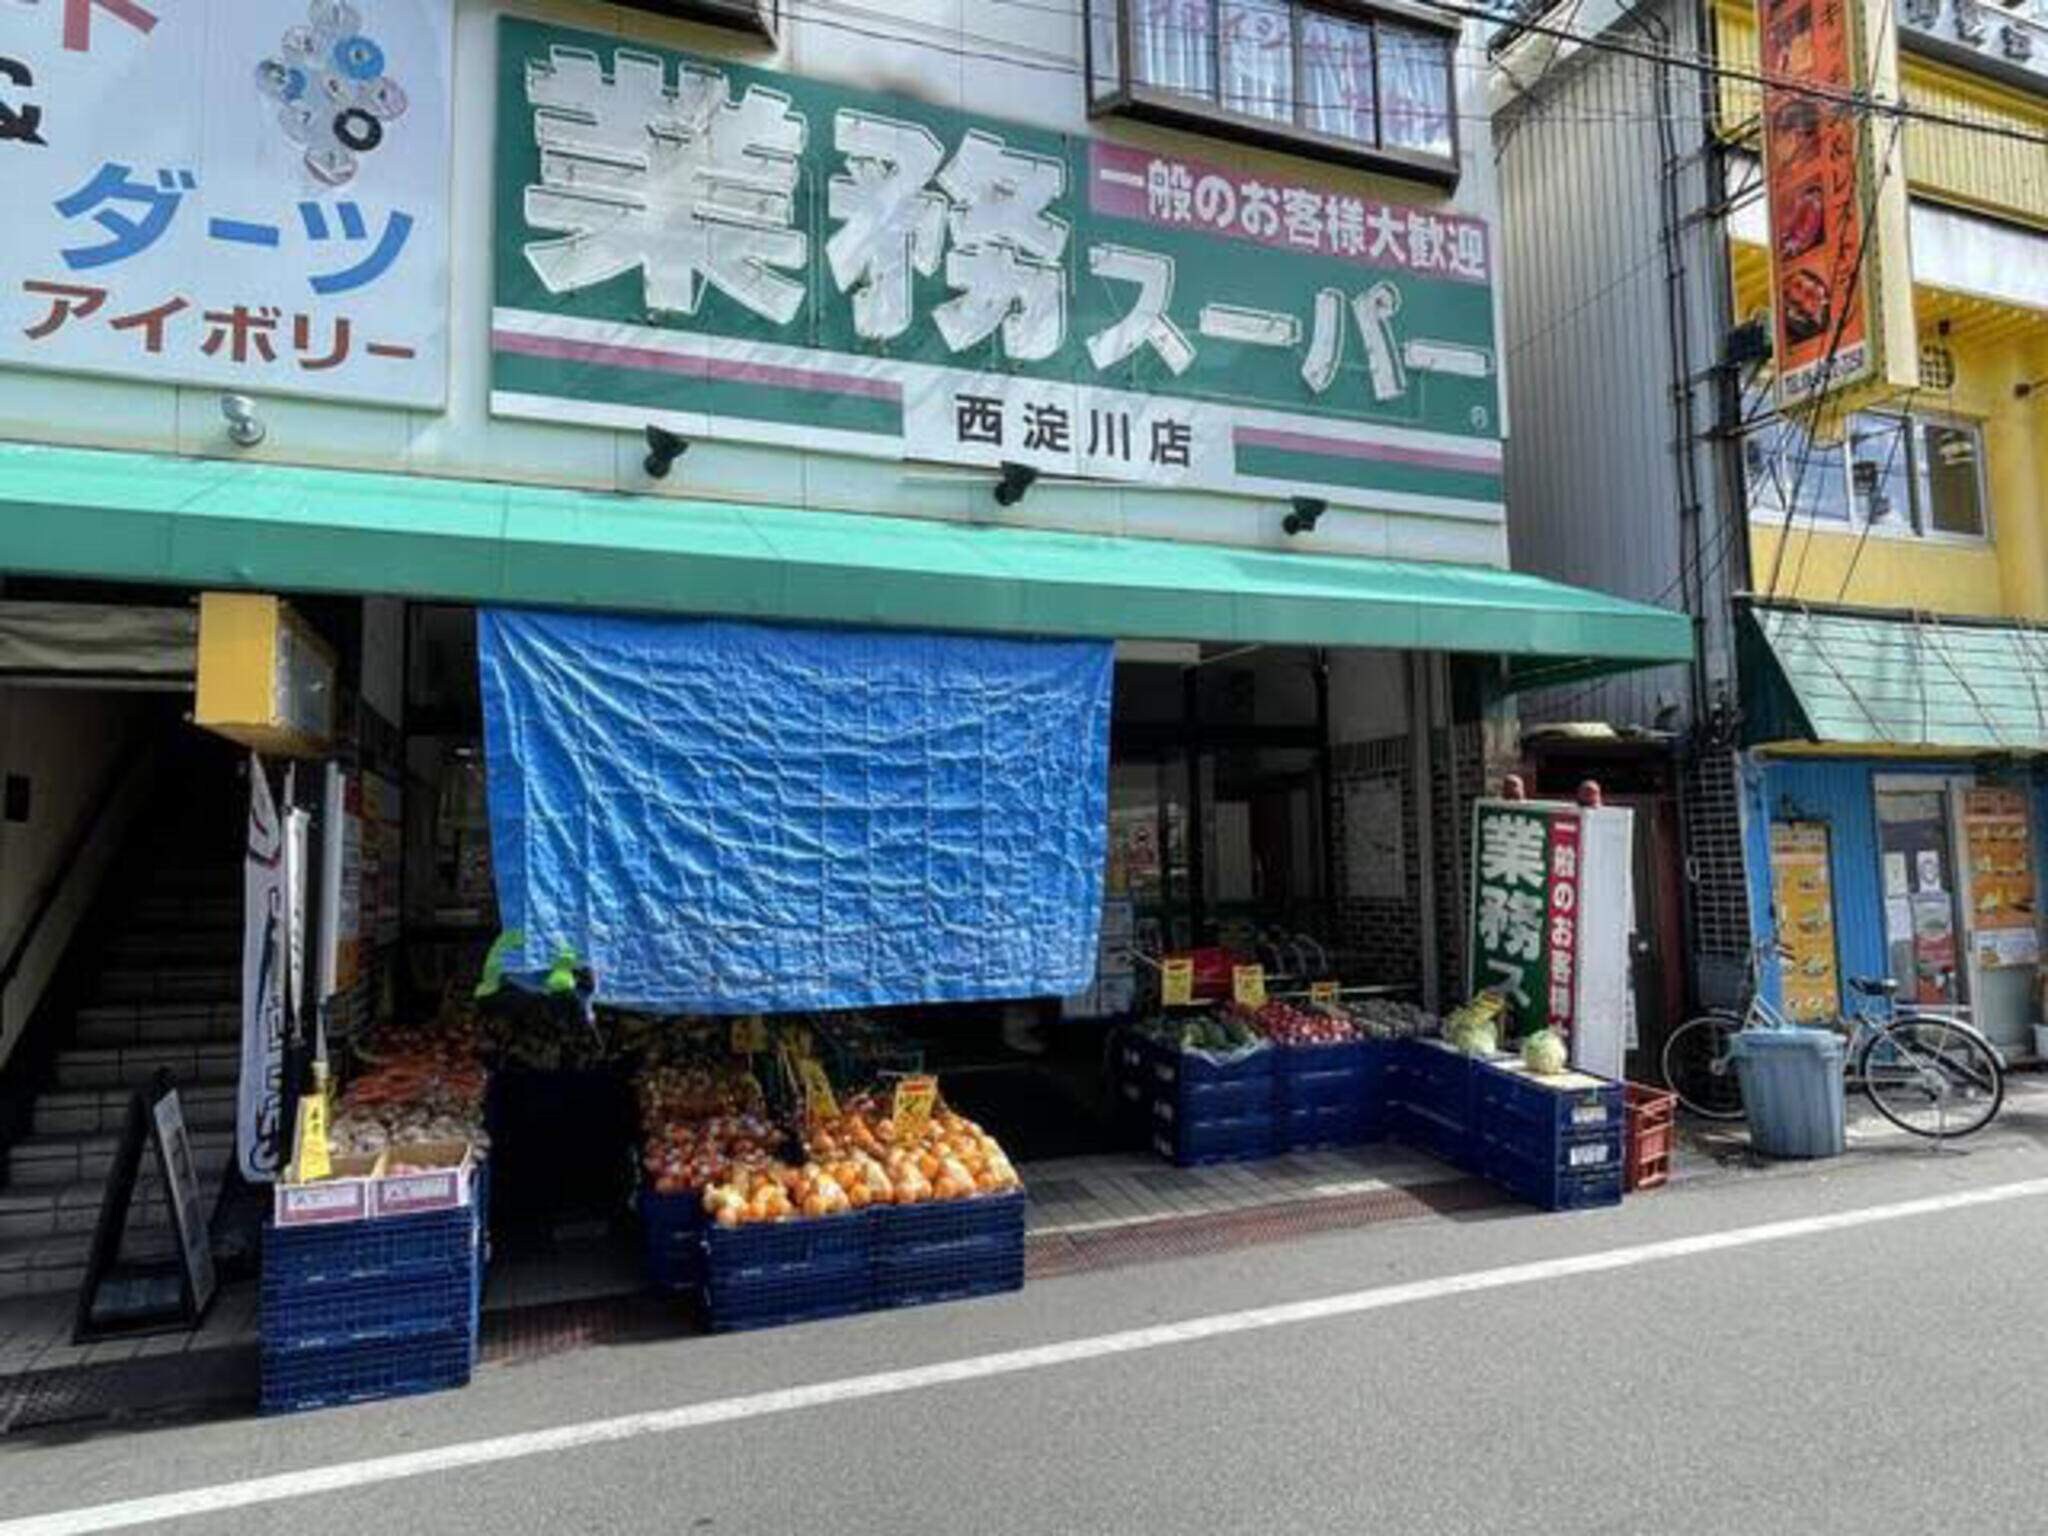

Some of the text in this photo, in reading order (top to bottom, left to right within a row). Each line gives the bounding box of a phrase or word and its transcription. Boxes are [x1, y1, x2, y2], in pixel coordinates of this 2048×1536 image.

[54, 163, 413, 294] ダーツ
[524, 45, 1493, 400] 業務スーパー
[1100, 160, 1486, 279] 一般のお客様大歓迎
[23, 280, 415, 369] アイボリー
[955, 394, 1191, 467] 西淀川店
